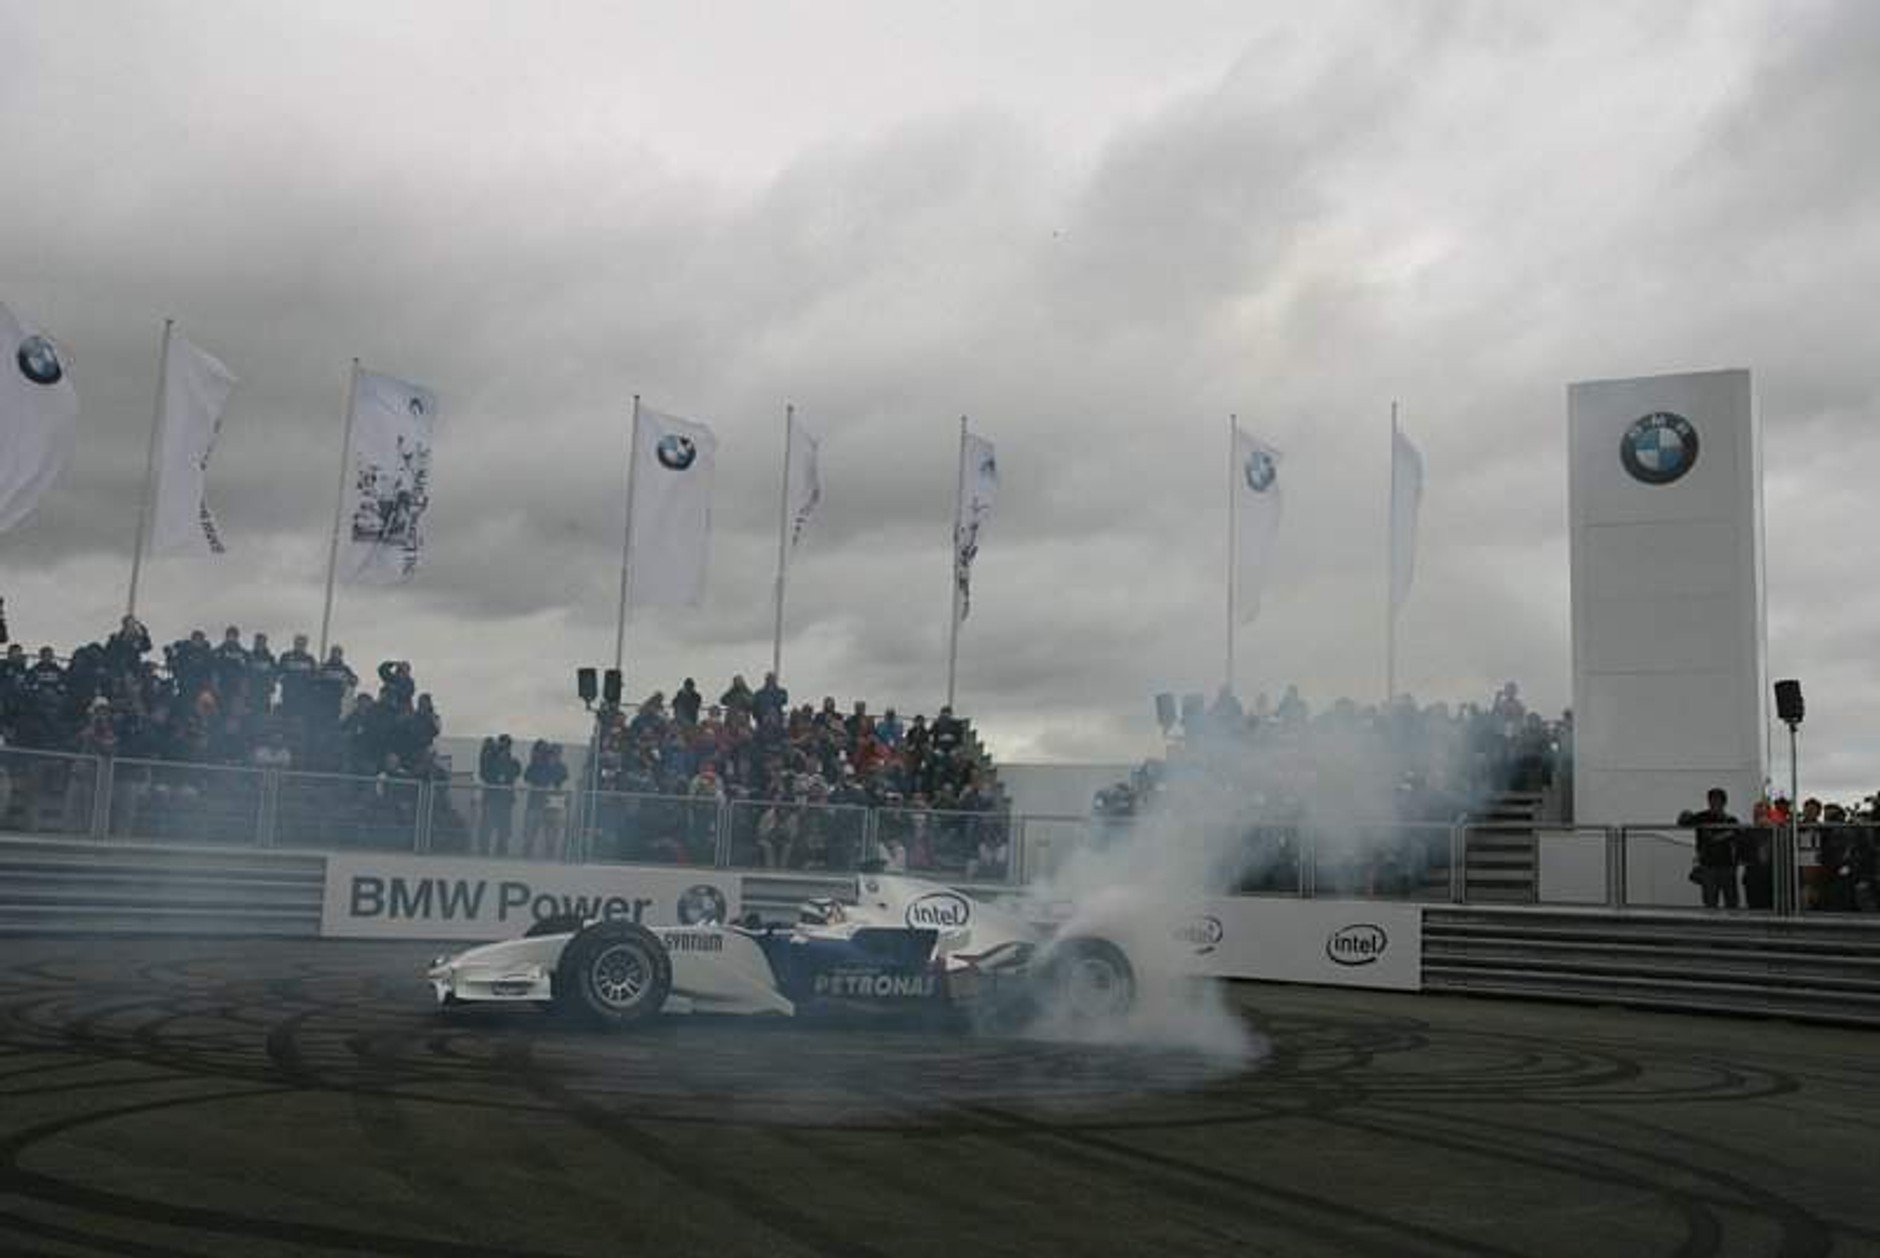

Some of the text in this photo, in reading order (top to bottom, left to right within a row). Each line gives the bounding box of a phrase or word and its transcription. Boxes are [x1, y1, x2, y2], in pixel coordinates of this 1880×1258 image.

[350, 875, 653, 923] BMW Power
[914, 901, 957, 925] intel
[1335, 931, 1376, 953] intel
[815, 974, 935, 996] PETRONAS
